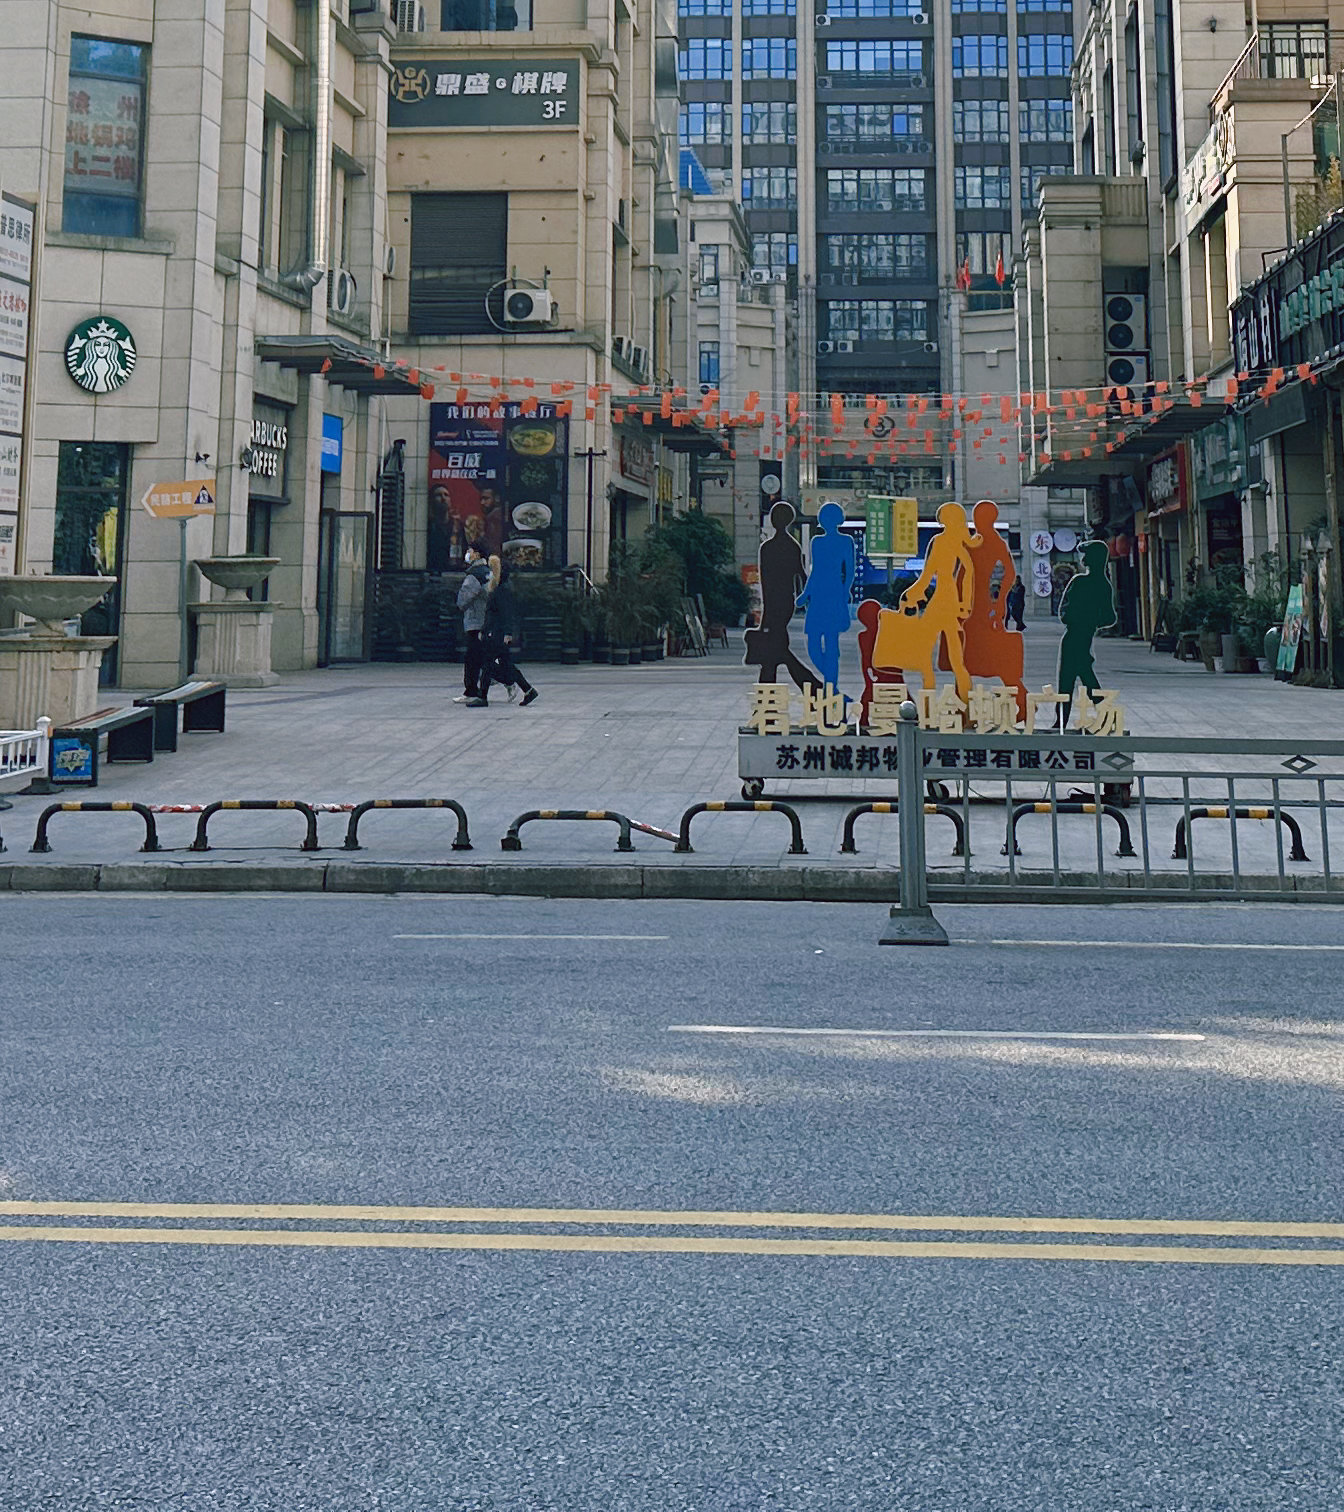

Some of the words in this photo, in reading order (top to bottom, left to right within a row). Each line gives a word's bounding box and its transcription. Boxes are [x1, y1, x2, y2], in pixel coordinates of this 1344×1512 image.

[542, 100, 567, 119] 3F
[248, 449, 278, 477] OFFEE
[447, 452, 483, 468] 百威
[775, 744, 1097, 771] 苏州诚邦物管理有限公司
